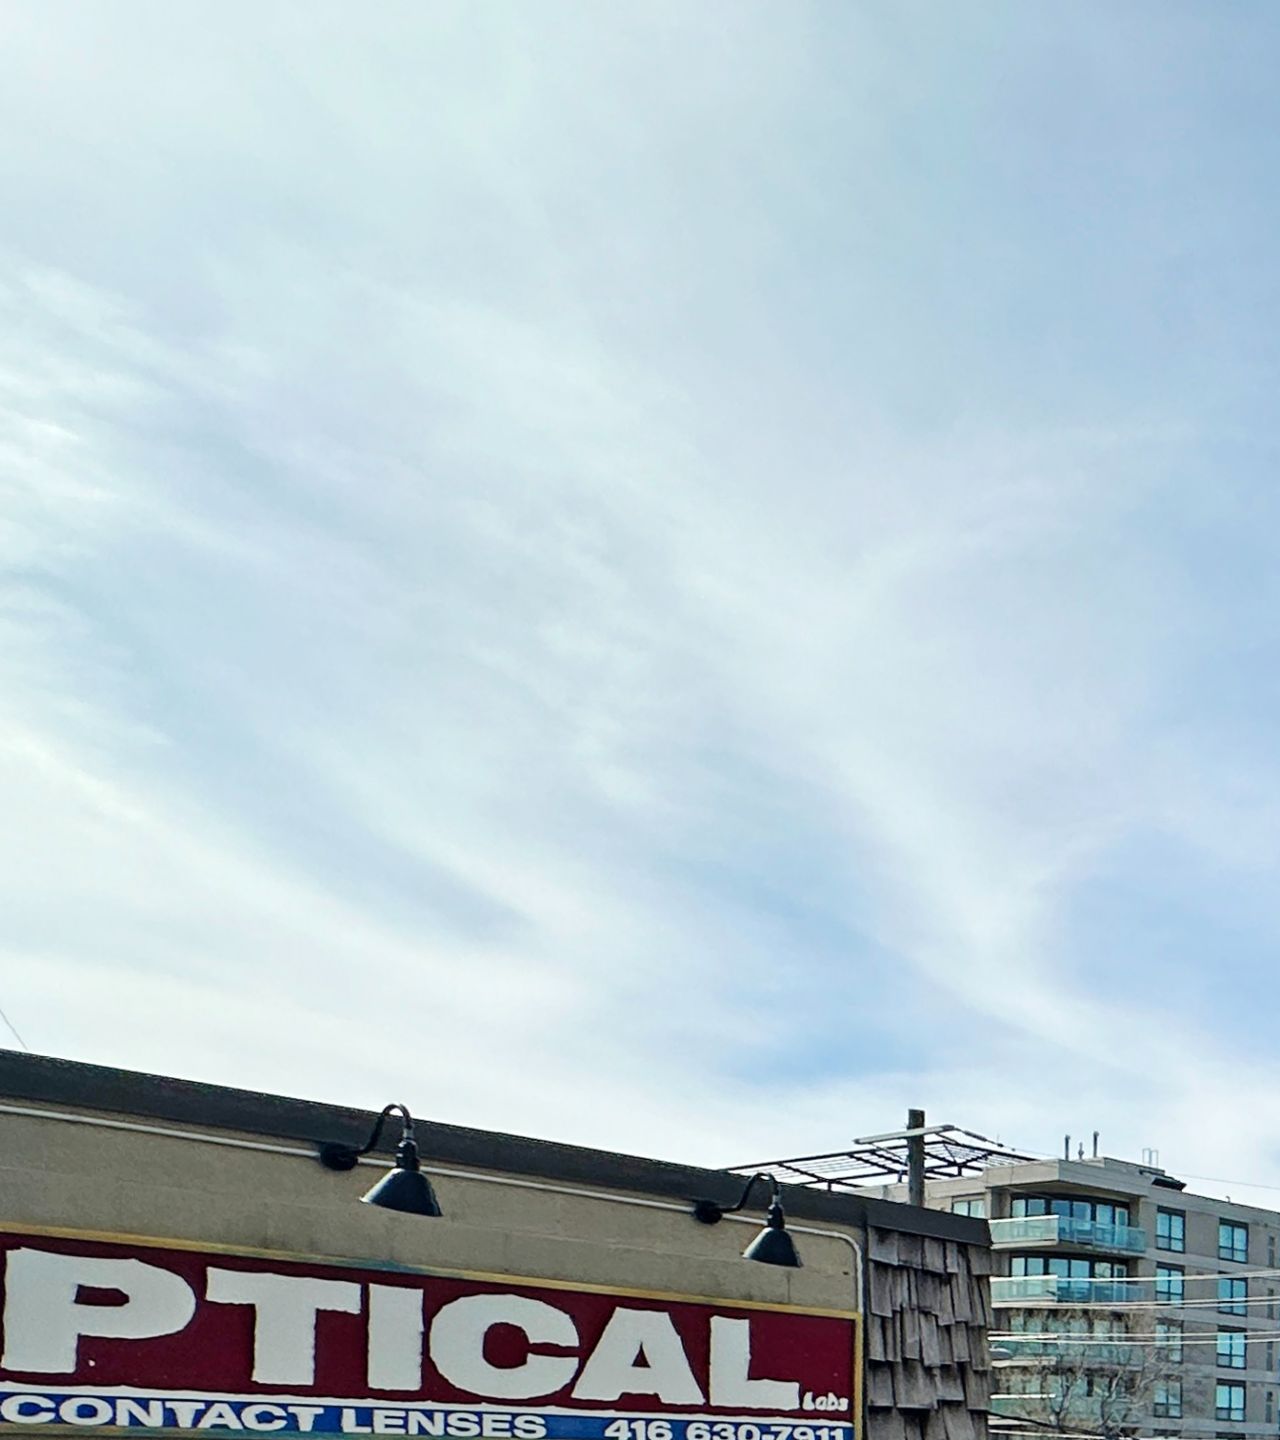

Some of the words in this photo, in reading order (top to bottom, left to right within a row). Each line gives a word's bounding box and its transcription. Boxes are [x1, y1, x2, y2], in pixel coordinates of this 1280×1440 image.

[1, 1395, 325, 1433] CONTACT
[341, 1407, 547, 1439] LENSES
[802, 1391, 849, 1412] Labs
